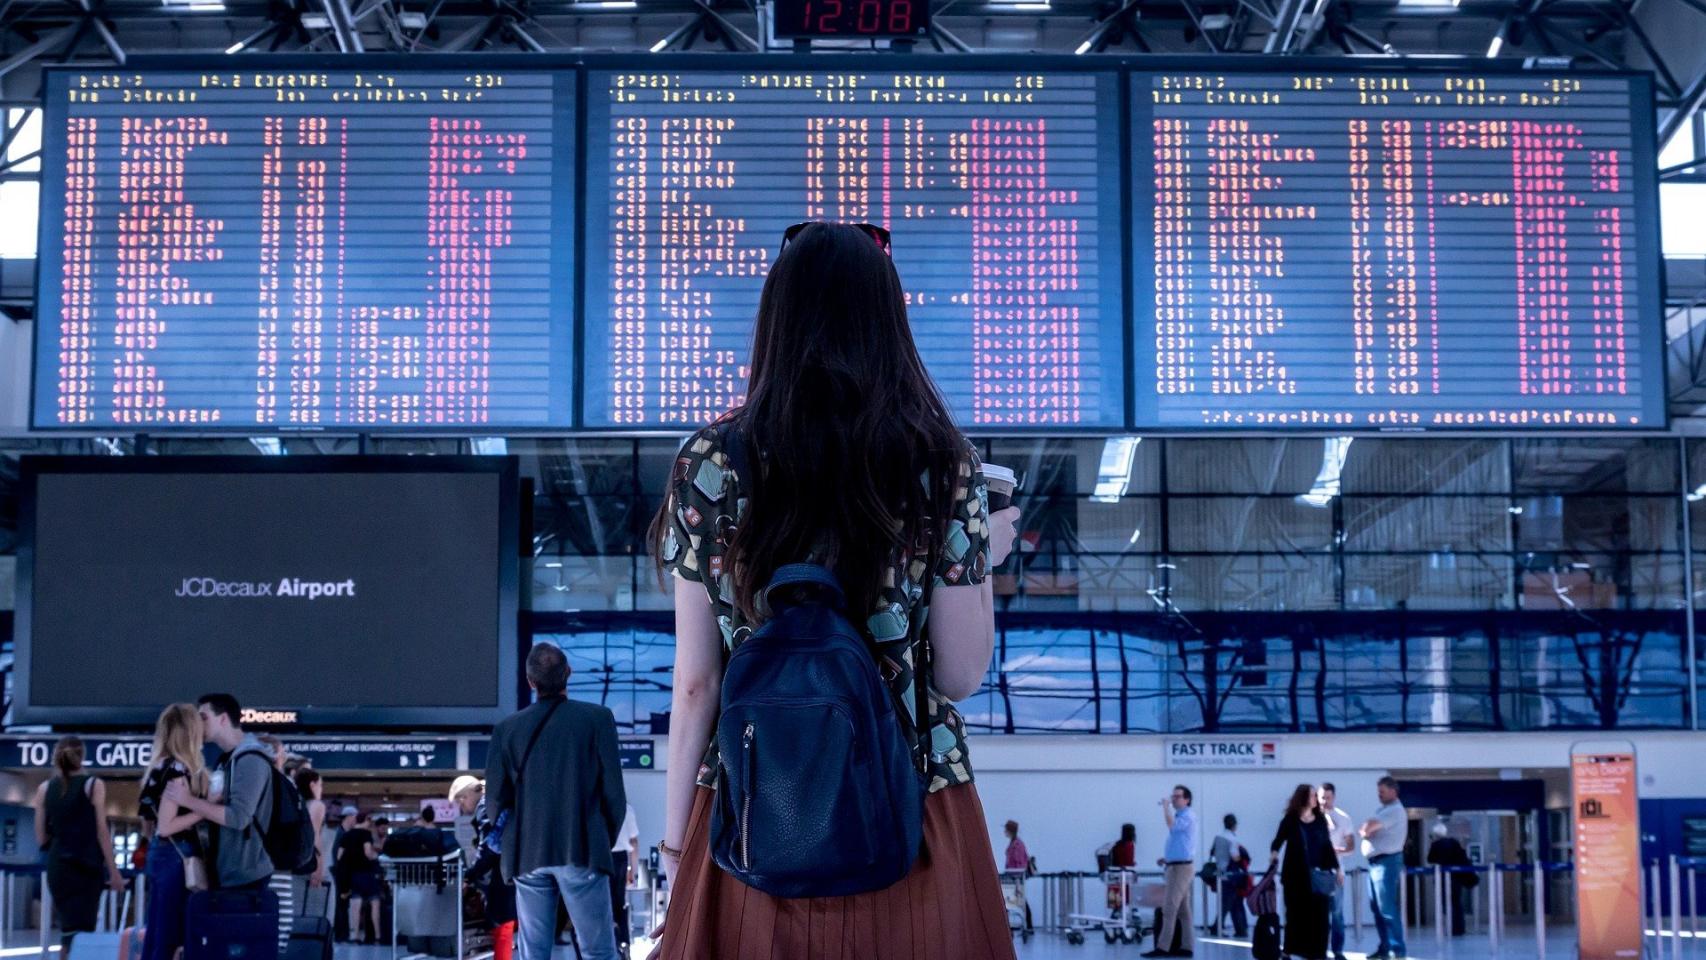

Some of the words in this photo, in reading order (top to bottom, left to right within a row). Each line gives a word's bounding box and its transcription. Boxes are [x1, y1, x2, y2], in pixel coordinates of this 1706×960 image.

[804, 0, 912, 32] 12:08
[175, 577, 273, 597] JCDecaux
[276, 578, 355, 600] Airport
[240, 709, 297, 723] Decaux
[17, 742, 49, 766] TO
[96, 742, 152, 766] GATE
[310, 743, 344, 752] PASSPORT
[345, 743, 359, 752] AND
[360, 743, 395, 752] BOARDING
[412, 743, 436, 752] READY
[1172, 743, 1205, 756] FAST
[1210, 743, 1255, 756] TRACK
